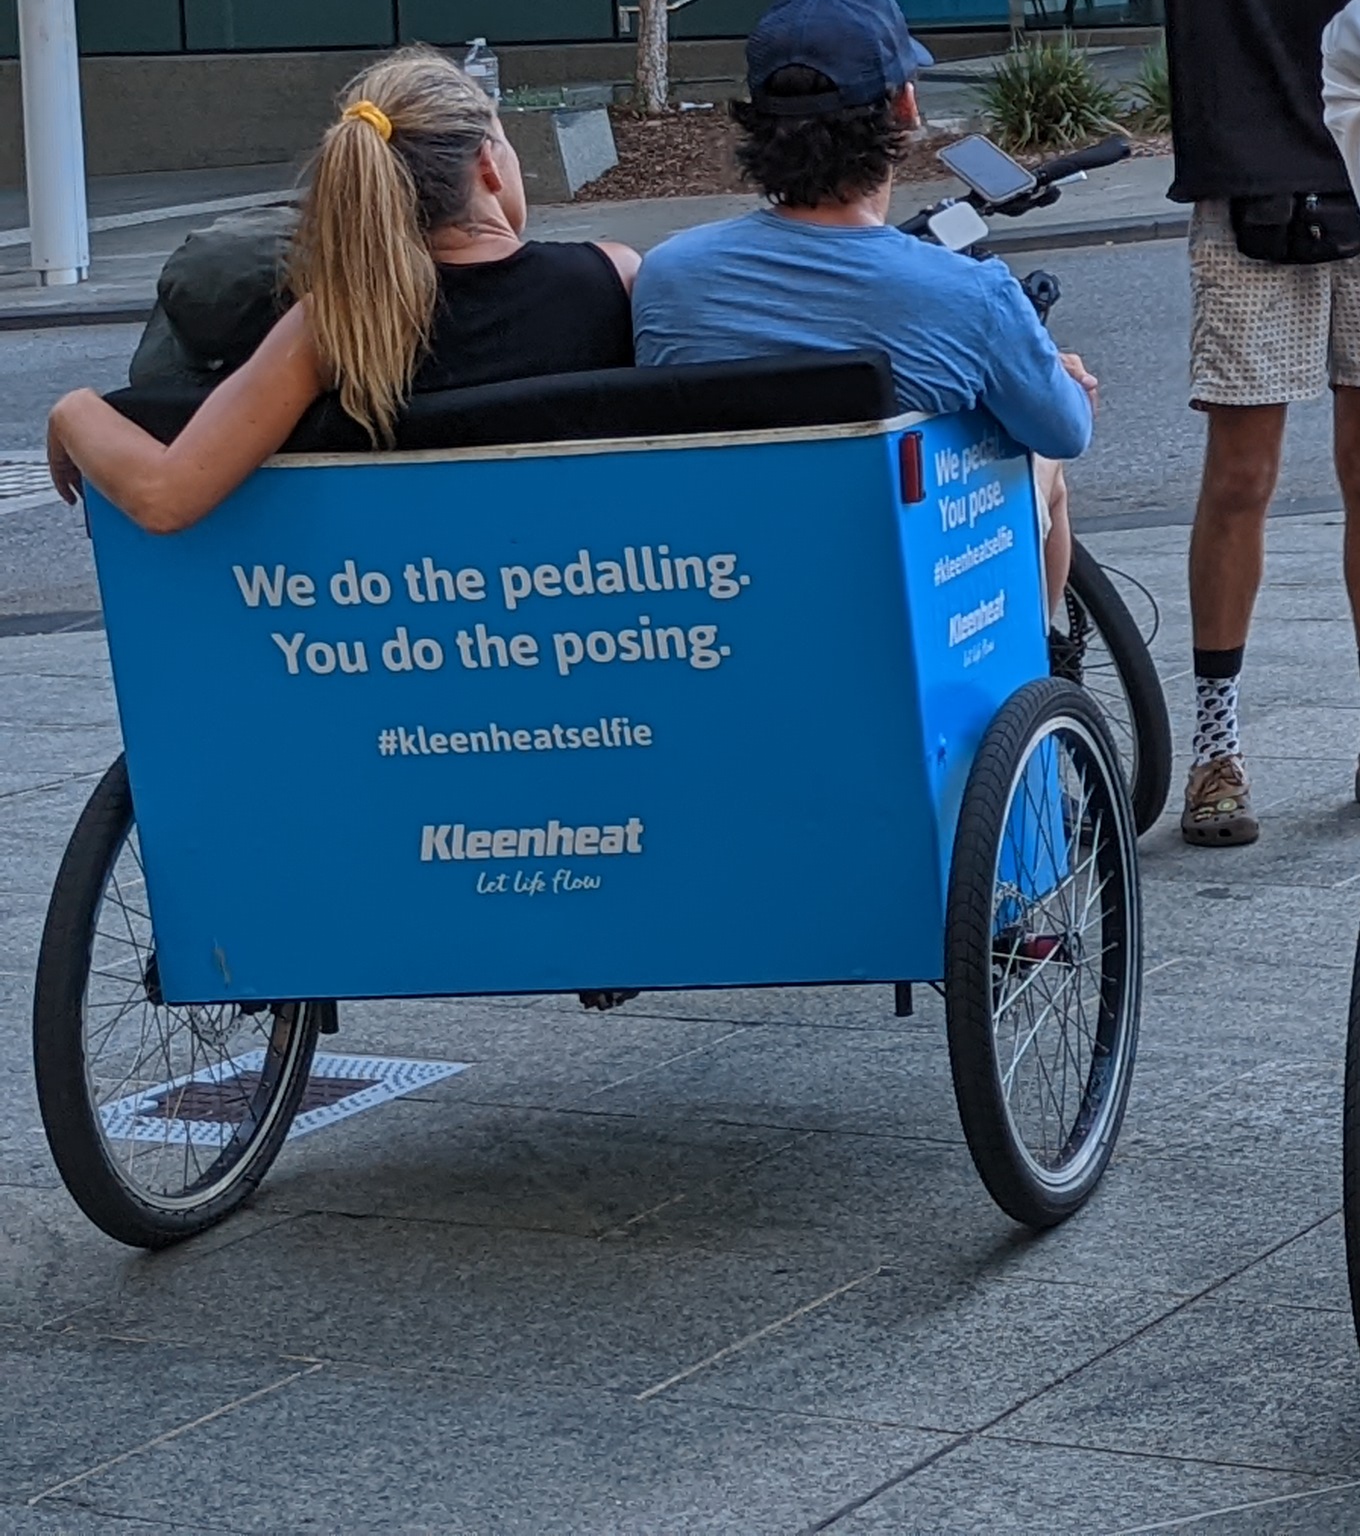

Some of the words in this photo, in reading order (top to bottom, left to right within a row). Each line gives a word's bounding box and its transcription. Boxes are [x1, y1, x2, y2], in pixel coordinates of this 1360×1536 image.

[934, 447, 960, 487] We
[937, 495, 967, 533] You
[968, 480, 1005, 529] pose.
[232, 564, 316, 608] We
[329, 559, 392, 606] do
[402, 556, 487, 603] the
[499, 544, 751, 611] pedalling.
[933, 524, 1014, 588] #kleenheatselfie
[270, 631, 369, 675] You
[381, 626, 444, 672] do
[455, 623, 540, 669] the
[552, 615, 731, 676] posing.
[949, 589, 1005, 649] Kleenheat
[378, 717, 653, 757] #kleenheatselfie
[420, 817, 644, 862] Kleenheat
